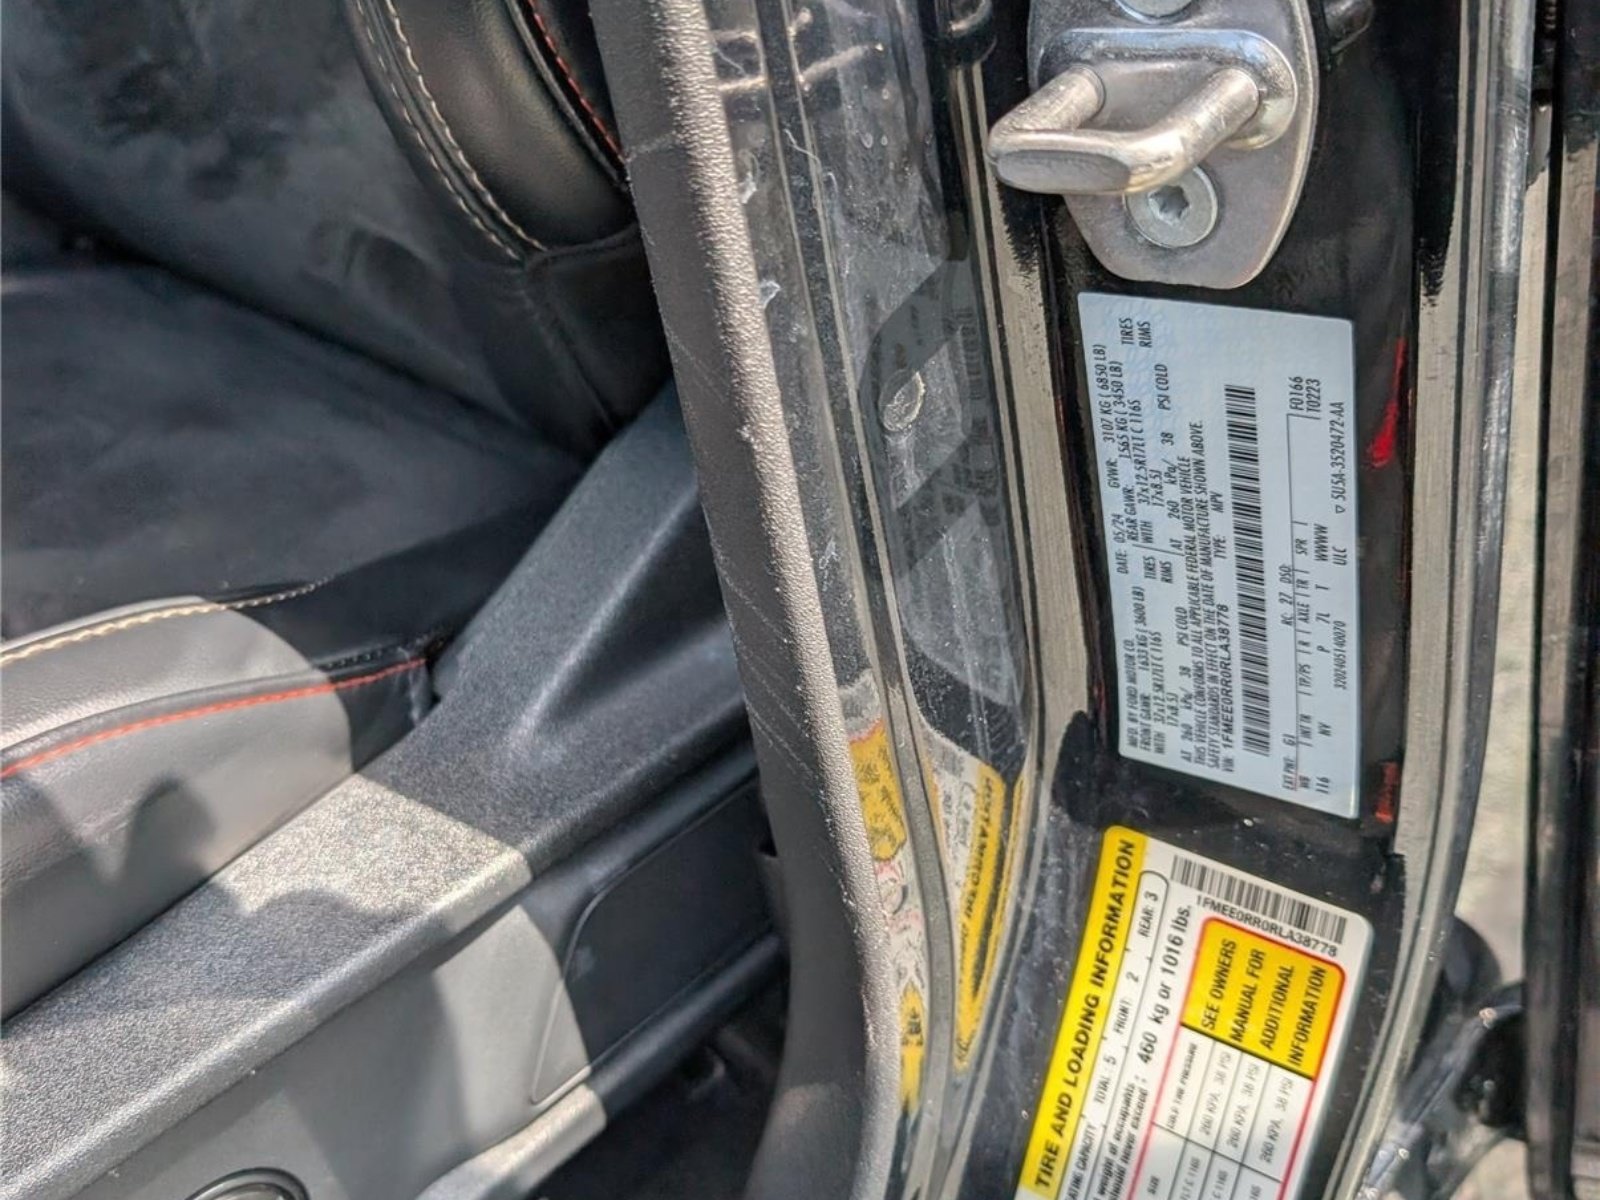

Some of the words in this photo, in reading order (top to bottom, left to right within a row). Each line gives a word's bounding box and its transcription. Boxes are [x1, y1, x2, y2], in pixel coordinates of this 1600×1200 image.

[1119, 318, 1134, 345] TIRES
[1137, 321, 1152, 347] RIMS
[1094, 364, 1109, 390] 6850
[1154, 364, 1169, 391] COLD
[1111, 380, 1125, 407] 3450
[1157, 394, 1171, 410] PSI
[1288, 376, 1303, 411] F0166
[1305, 378, 1320, 412] T0223
[1098, 401, 1111, 414] KG
[1127, 399, 1142, 423] 116S
[1101, 418, 1115, 443] 3107
[1115, 417, 1127, 431] KG
[1116, 434, 1130, 458] 1565
[1160, 432, 1174, 445] 38
[1177, 456, 1192, 494] VEHICLE
[1192, 458, 1207, 496] SHOWN
[1166, 500, 1180, 519] 260
[1210, 491, 1223, 513] MPV
[1180, 497, 1195, 532] MOTOR
[1111, 513, 1126, 544] 05/24
[1125, 517, 1139, 541] REAR
[1140, 521, 1153, 544] WITH
[1195, 498, 1212, 567] MANUFACTURE
[1169, 538, 1183, 550] AT
[1184, 535, 1198, 573] FEDERAL
[1295, 538, 1307, 555] SPR
[1314, 524, 1328, 562] WWWW
[1143, 556, 1156, 580] TIRES
[1332, 546, 1347, 566] ULC
[1159, 561, 1173, 583] RIMS
[1200, 568, 1213, 581] OF
[1296, 578, 1309, 589] TR
[1186, 575, 1201, 627] APPLICABLE
[1200, 583, 1215, 606] DATE
[1278, 592, 1292, 605] 27
[1133, 602, 1146, 626] 3600
[1174, 606, 1188, 630] COLD
[1202, 608, 1215, 625] THE
[1296, 602, 1309, 623] AXLE
[1136, 634, 1147, 647] KG
[1190, 630, 1203, 644] ALL
[1204, 627, 1217, 641] ON
[1136, 648, 1149, 671] 1633
[1191, 646, 1204, 658] TO
[1204, 642, 1218, 672] EFFECT
[1192, 660, 1206, 707] CONFORMS
[1207, 674, 1219, 684] IN
[1126, 686, 1138, 710] FORD
[1204, 684, 1221, 736] STANDARDS
[1193, 708, 1206, 743] VEHICLE
[1205, 736, 1221, 769] SAFETY
[1144, 891, 1158, 902] 3
[1171, 905, 1191, 933] lbs.
[1161, 934, 1184, 975] 1016
[1126, 971, 1139, 983] 2
[1210, 939, 1237, 1000] OWNERS
[1158, 982, 1172, 1000] or
[1229, 984, 1257, 1042] MANUAL
[1246, 949, 1265, 979] FOR
[1036, 1141, 1059, 1188] TIRE
[1053, 1092, 1072, 1138] AND
[1064, 994, 1100, 1088] LOADING
[1090, 840, 1135, 988] INFORMATION
[1148, 1004, 1170, 1025] kg
[1202, 1004, 1220, 1030] SEE
[1260, 966, 1294, 1050] ADDITIONAL
[1288, 966, 1327, 1066] INFORMATION
[1137, 1032, 1158, 1064] 460
[1103, 1056, 1116, 1065] 5
[1260, 1142, 1274, 1163] 260
[1278, 1077, 1293, 1096] PSI
[1075, 1125, 1093, 1171] CAPACITY
[1068, 1174, 1083, 1200] ATING
